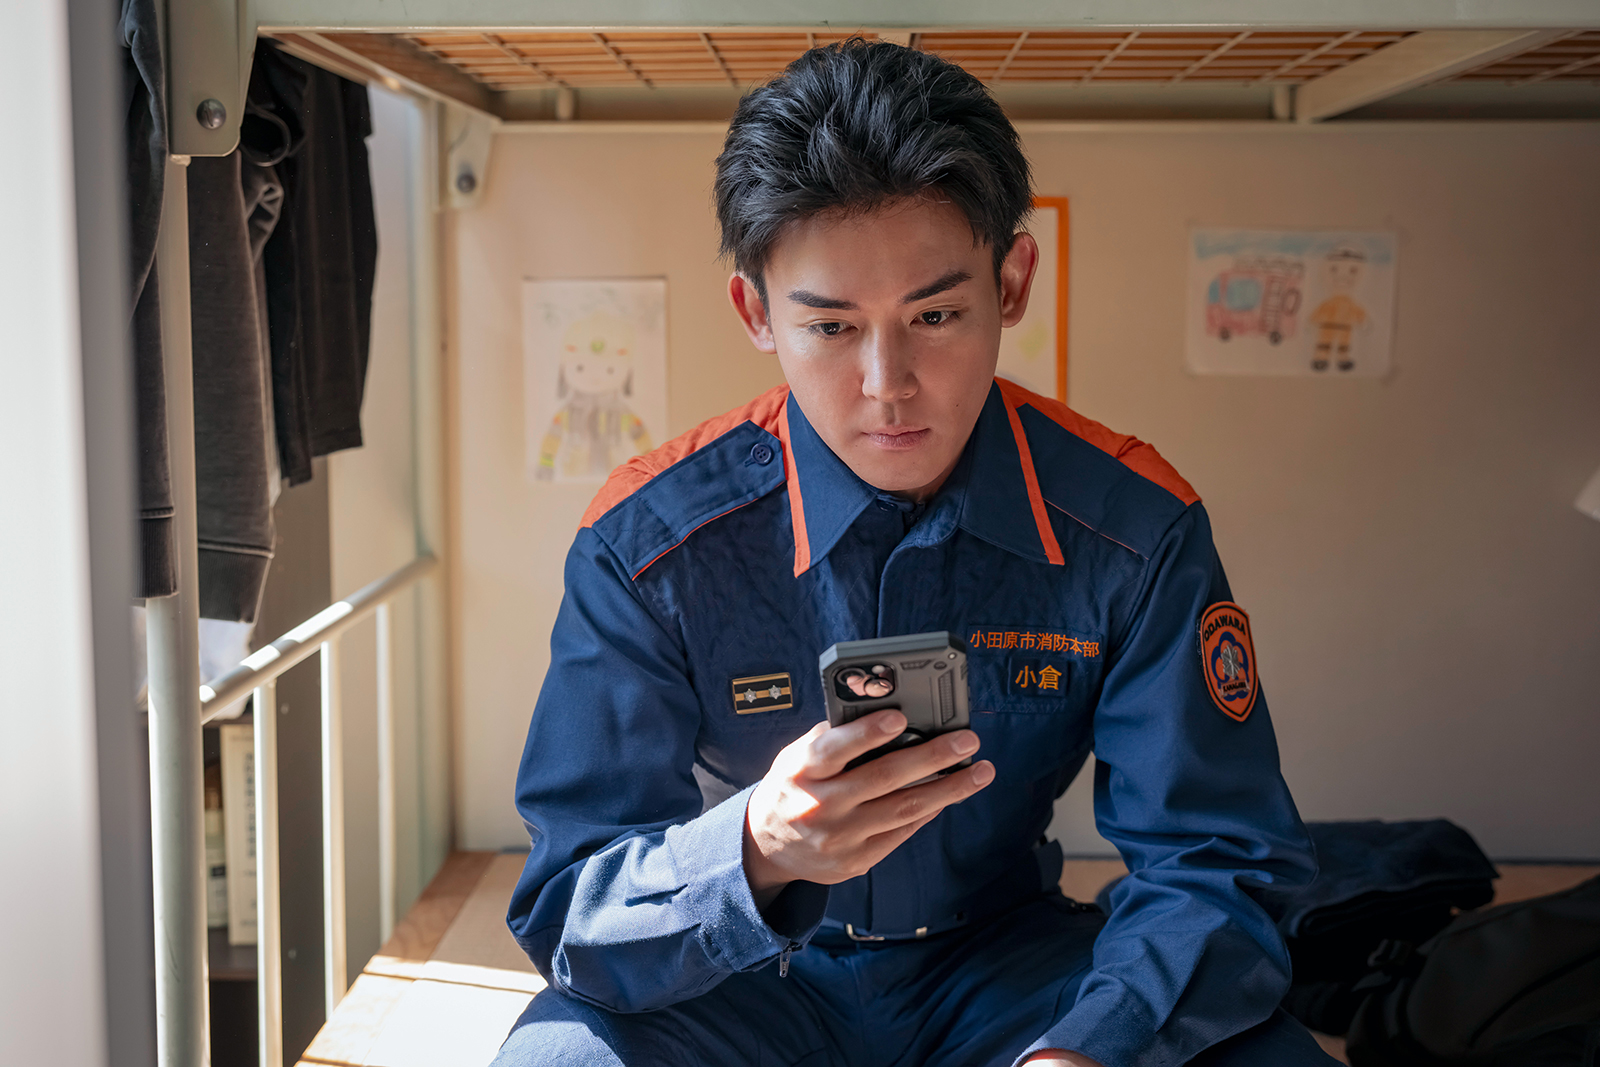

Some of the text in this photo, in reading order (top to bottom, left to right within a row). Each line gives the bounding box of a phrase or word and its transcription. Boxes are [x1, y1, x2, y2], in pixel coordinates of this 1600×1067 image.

[1204, 614, 1246, 642] ODAWARA
[970, 630, 1100, 657] 小田原市消防本部
[1015, 664, 1062, 690] 小倉
